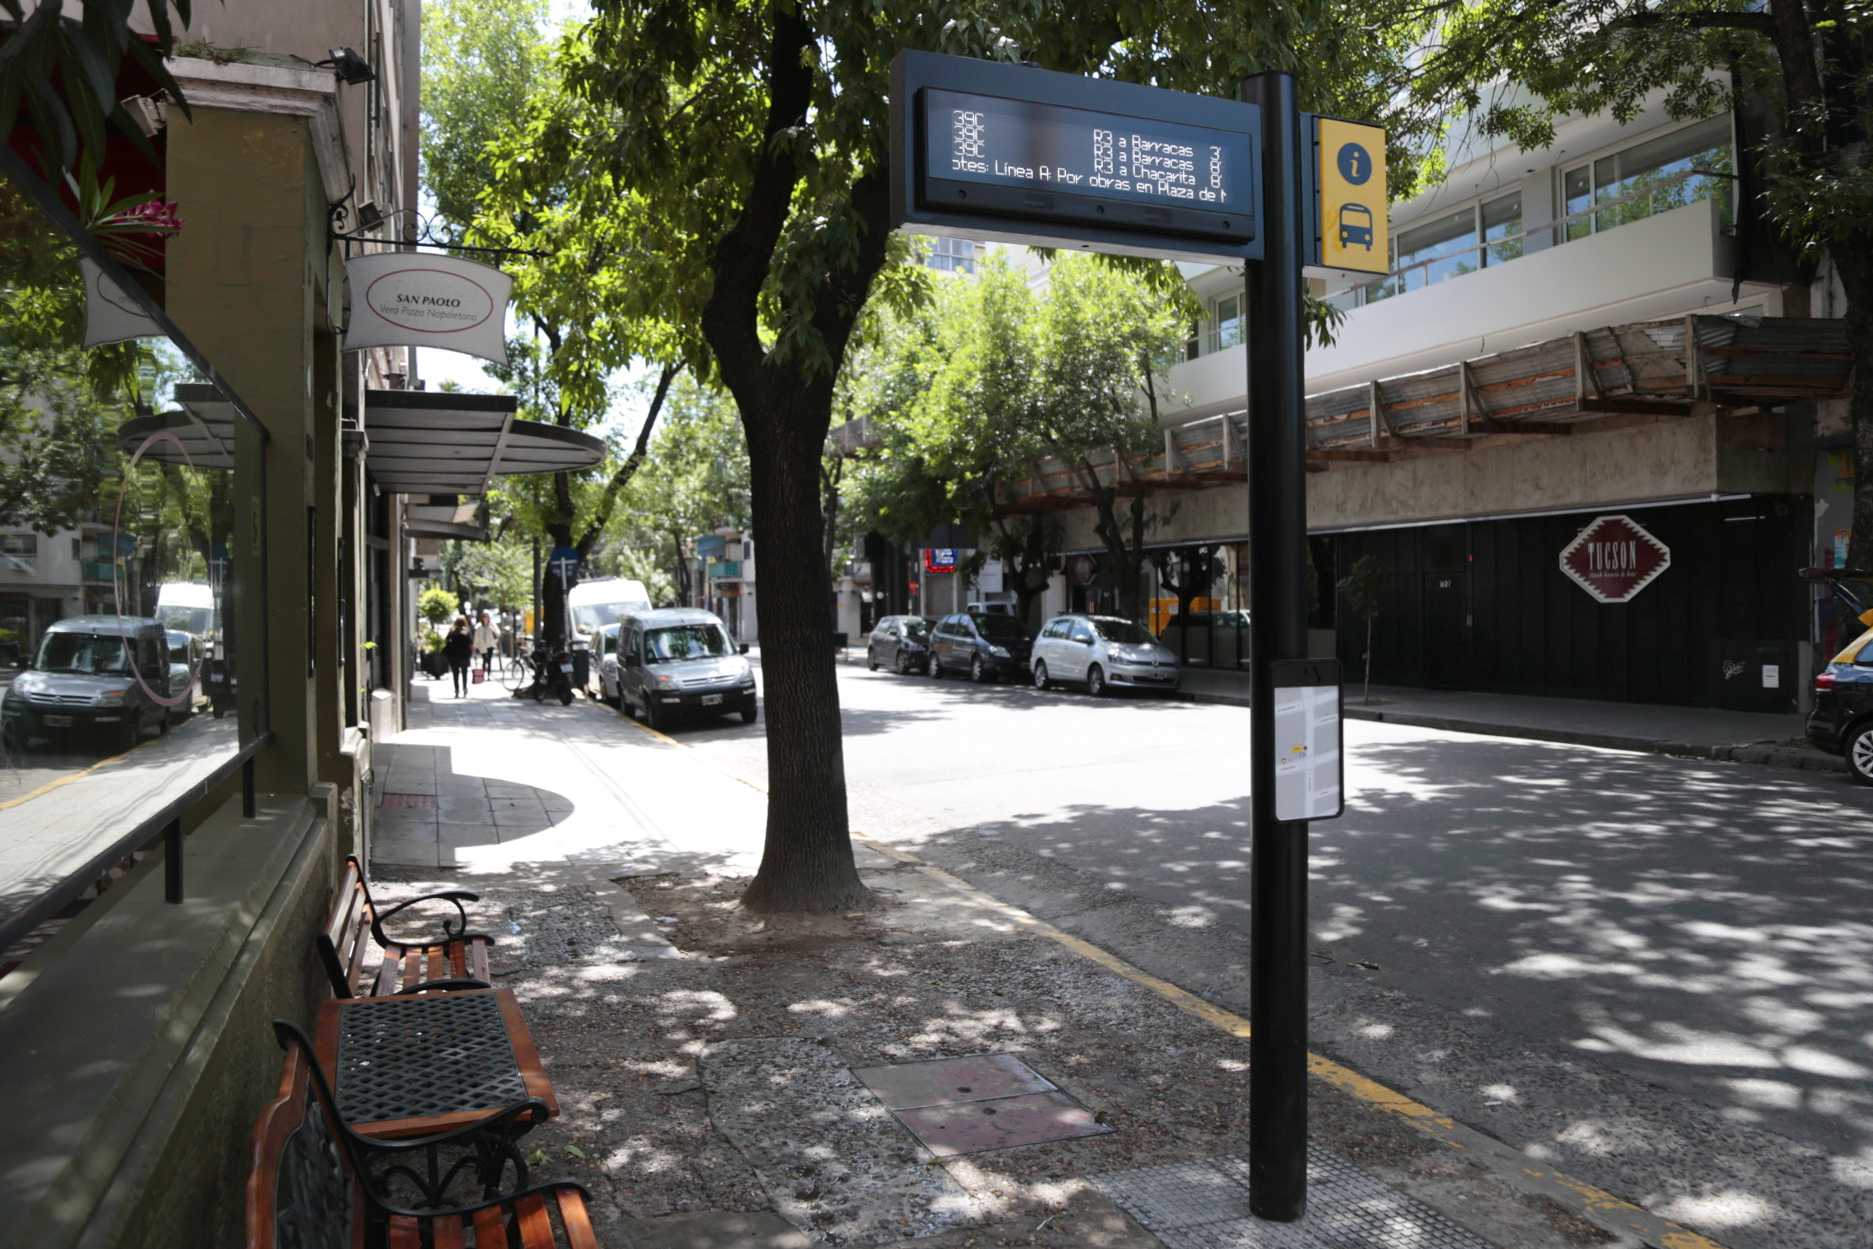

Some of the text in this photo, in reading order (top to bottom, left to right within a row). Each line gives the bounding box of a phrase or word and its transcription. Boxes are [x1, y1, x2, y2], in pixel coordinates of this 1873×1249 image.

[954, 110, 985, 128] 39C
[1093, 129, 1113, 146] R3
[1118, 137, 1127, 148] a
[1131, 134, 1194, 158] Barracas
[954, 125, 985, 143] 39C
[1094, 144, 1114, 161] R3
[1119, 151, 1127, 162] a
[1132, 148, 1194, 171] Barracas
[954, 140, 986, 158] 39C
[1094, 158, 1114, 175] R3
[1120, 165, 1128, 176] a
[1132, 163, 1196, 186] Chacarita
[995, 160, 1034, 180] Línea
[1057, 167, 1083, 184] Por
[1089, 173, 1131, 191] obras
[1136, 182, 1153, 194] en
[1158, 181, 1194, 199] Plaza
[1198, 187, 1216, 202] de
[380, 304, 478, 321] Vera Pizza Napoletana
[396, 293, 461, 308] SAN PAOLO
[1588, 540, 1636, 570] TUCSON
